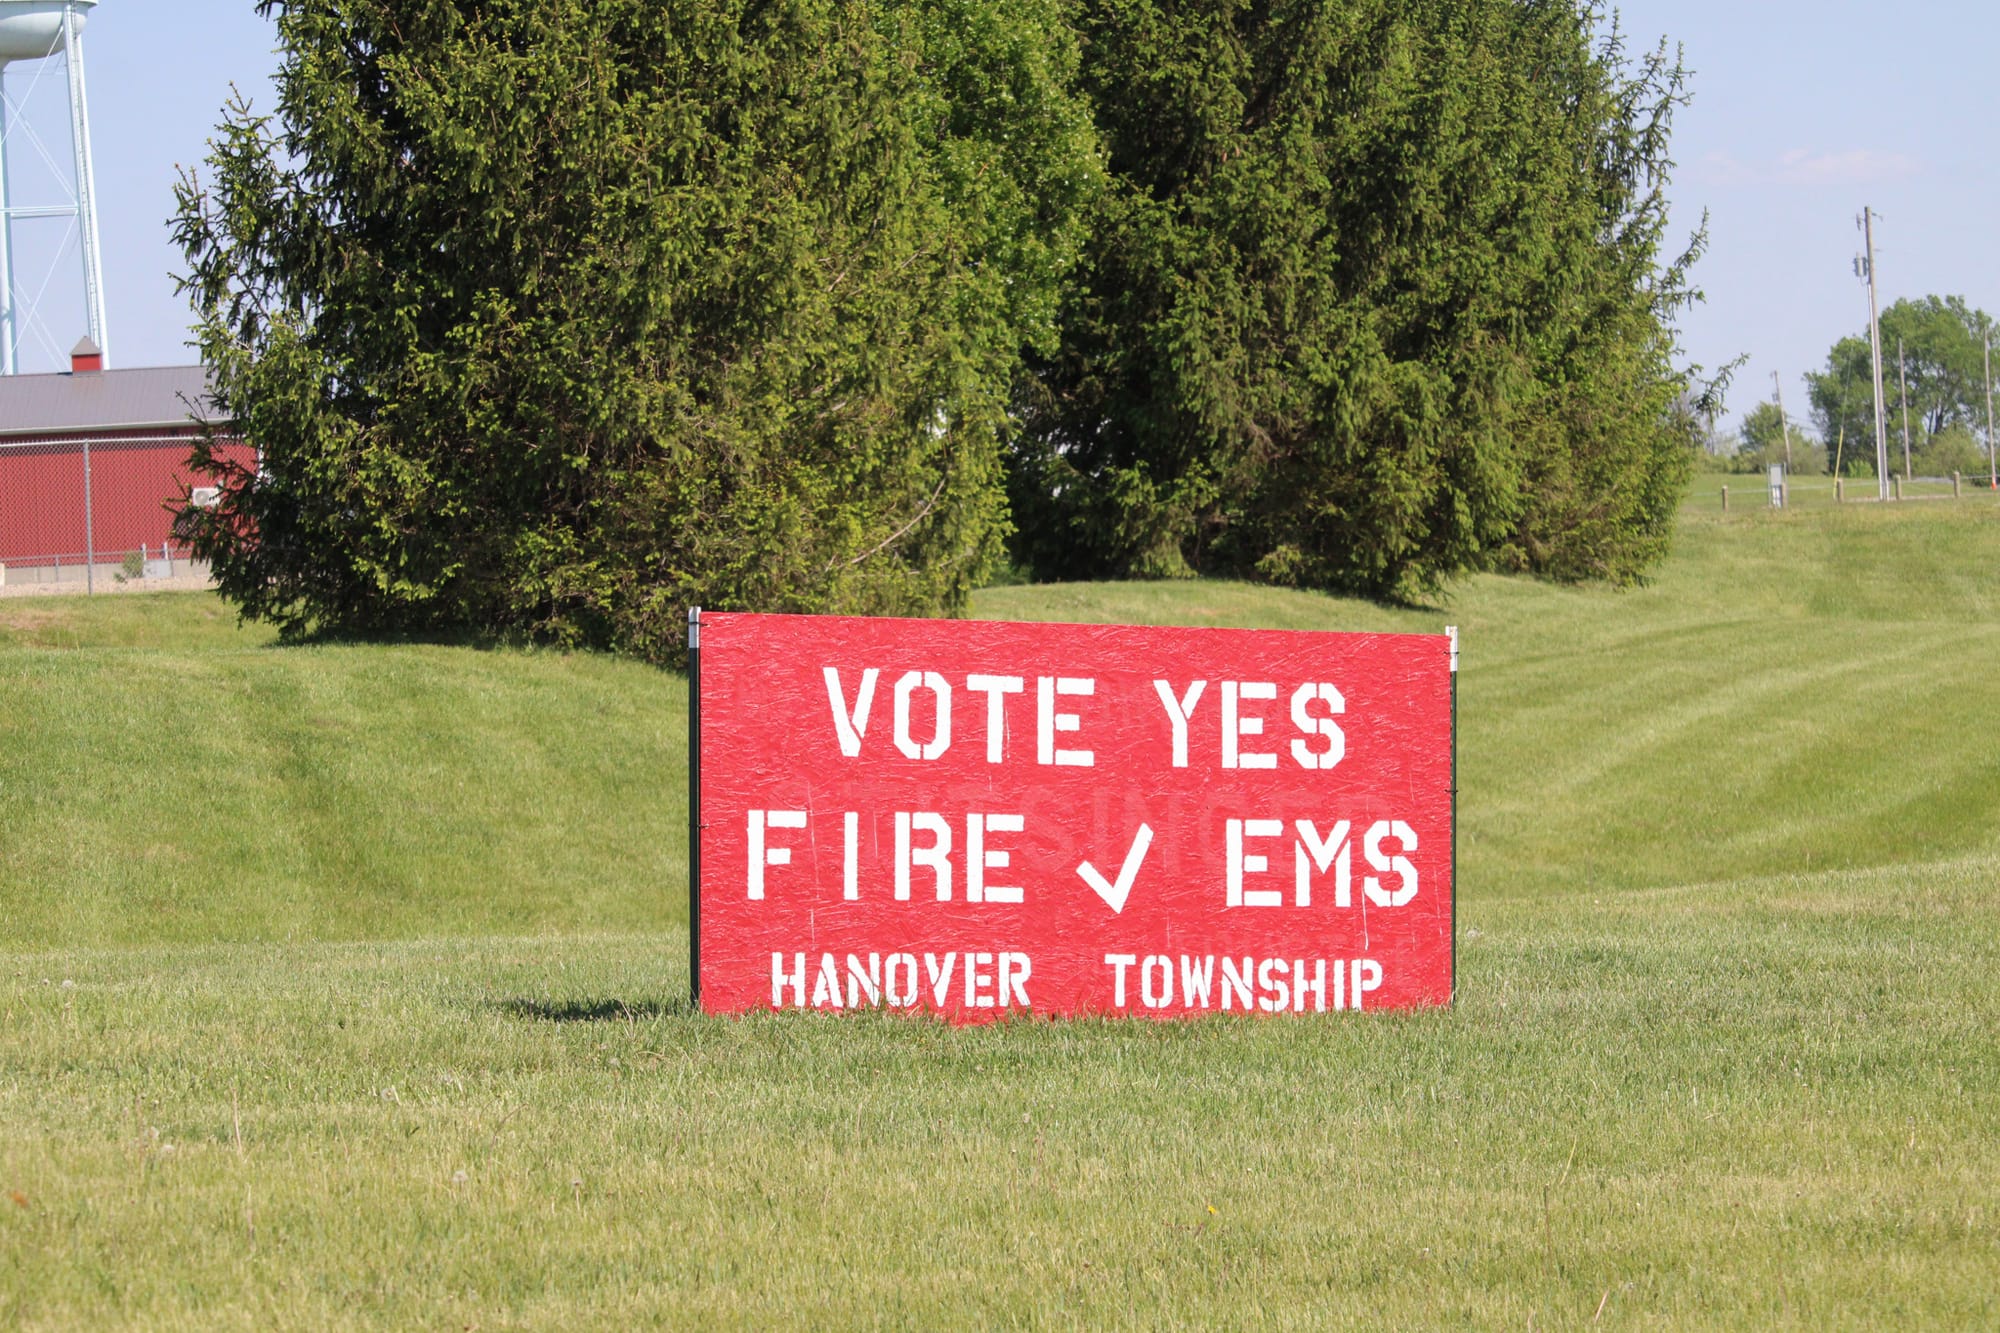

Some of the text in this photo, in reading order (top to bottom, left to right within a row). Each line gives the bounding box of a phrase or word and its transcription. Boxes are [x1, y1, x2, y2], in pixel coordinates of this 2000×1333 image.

[823, 667, 1346, 770] VOTE YES
[747, 810, 1025, 903] FIRE
[1226, 819, 1419, 908] EMS
[771, 952, 1383, 1014] HANOVER TOWNSHIP
